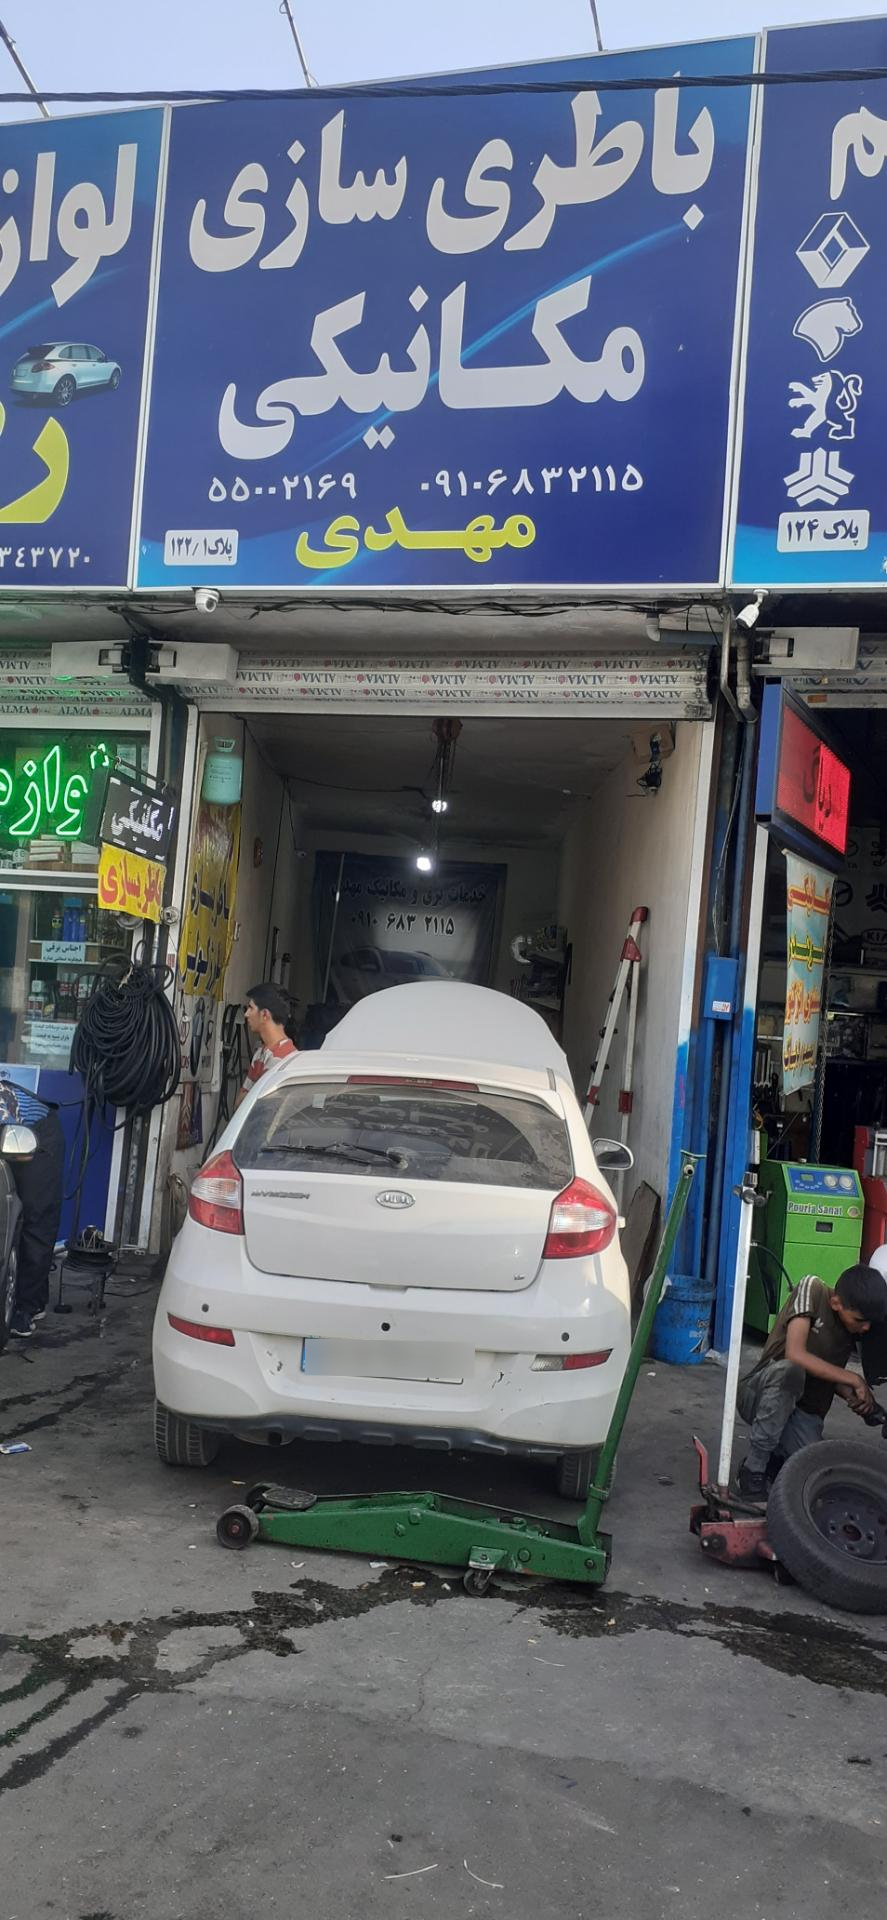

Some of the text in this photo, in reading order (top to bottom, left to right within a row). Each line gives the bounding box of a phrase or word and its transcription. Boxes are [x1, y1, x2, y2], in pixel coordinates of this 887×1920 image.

[189, 72, 715, 272] باطری سازی
[218, 276, 645, 460] مکانیکی
[208, 473, 357, 502] ۵۵۰۰۲۱۶۹
[421, 463, 643, 497] ۰۹۱۰۶۸۳۲۱۱۵
[295, 506, 536, 569] مهدی
[787, 518, 859, 546] پلاک ۱۲۴
[237, 672, 679, 685] ALMA ALMA ALMA ALMA ALMA ALMA ALMA
[59, 706, 91, 715] ALMA
[386, 912, 416, 933] ۶۸۳
[424, 915, 455, 935] ۲۱۱۵
[788, 1202, 816, 1214] Pouria
